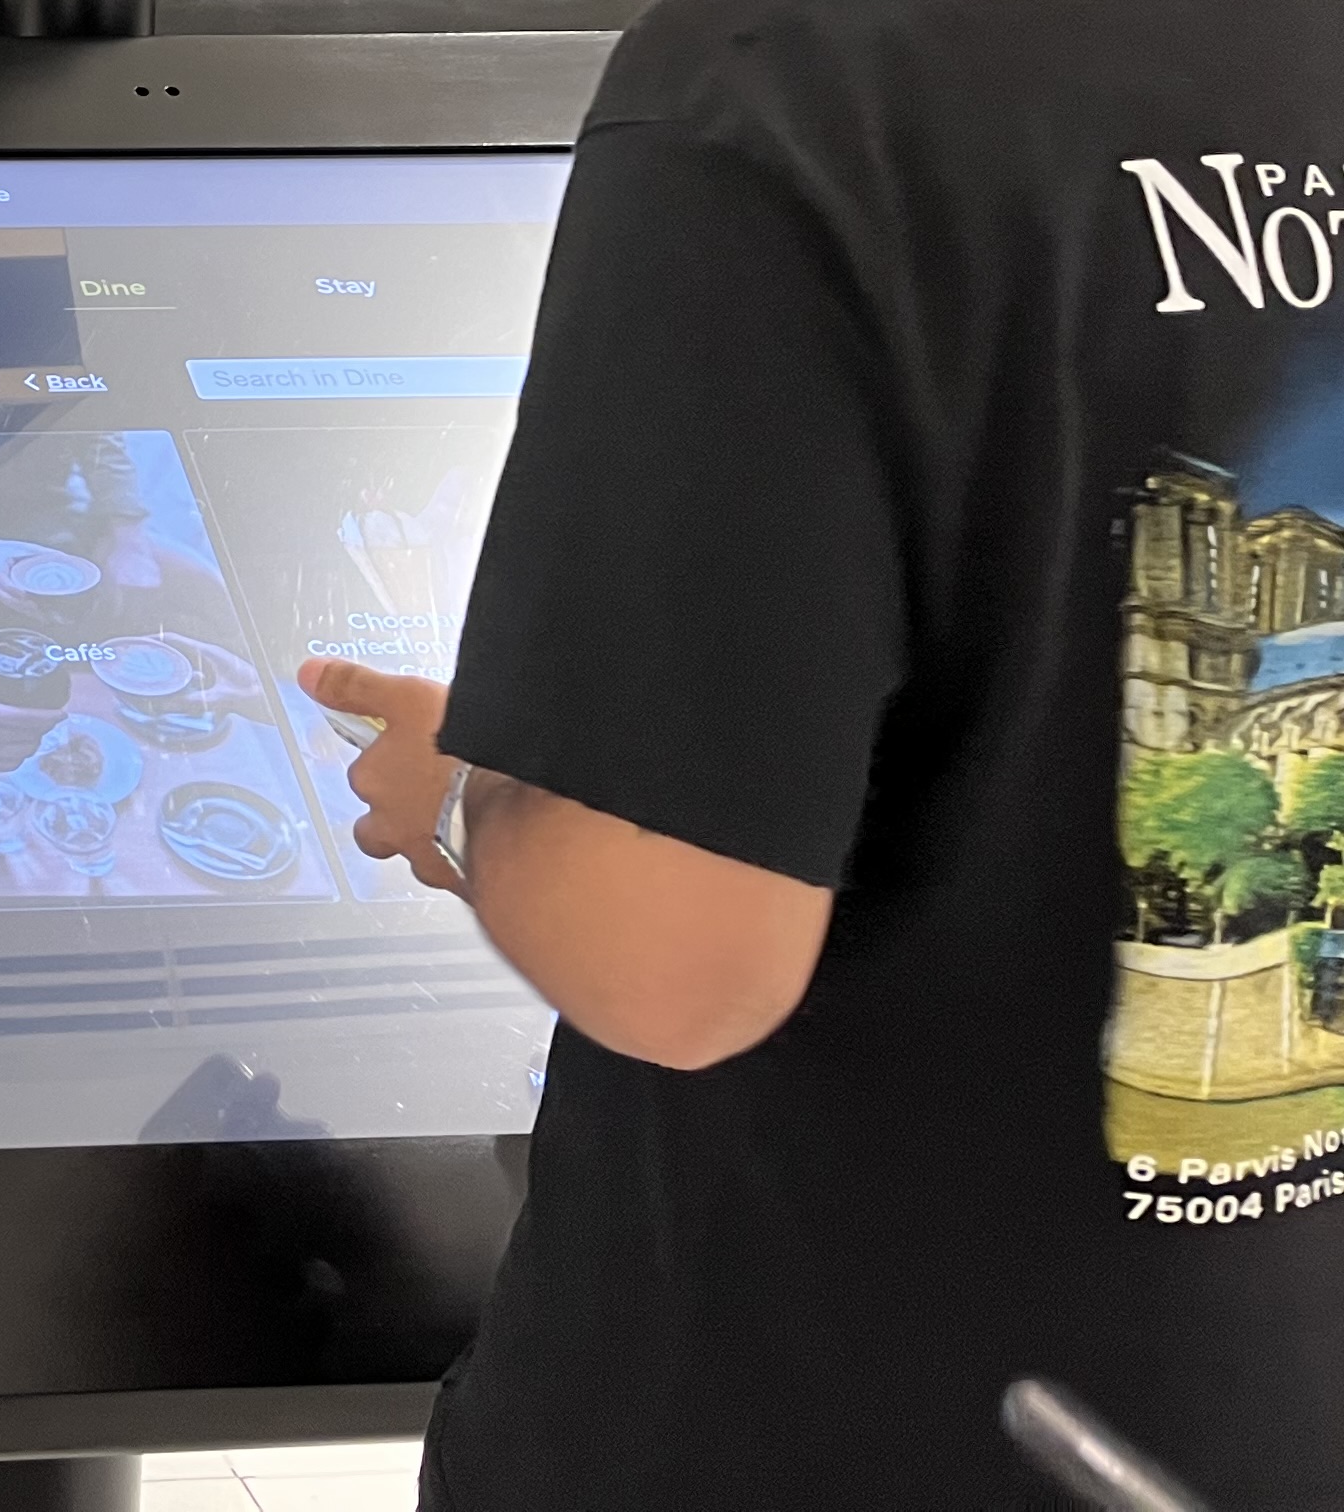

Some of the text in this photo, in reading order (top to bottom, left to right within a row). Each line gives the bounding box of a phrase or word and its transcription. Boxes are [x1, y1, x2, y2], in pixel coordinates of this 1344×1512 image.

[1254, 162, 1344, 198] PA
[79, 278, 147, 298] Dine
[315, 276, 377, 299] Stay
[46, 372, 106, 390] Back
[212, 368, 405, 390] Search in Dine
[45, 642, 116, 664] Cafés
[1127, 1127, 1344, 1185] 6 Parvis No
[1122, 1169, 1344, 1224] 75004 Paris
